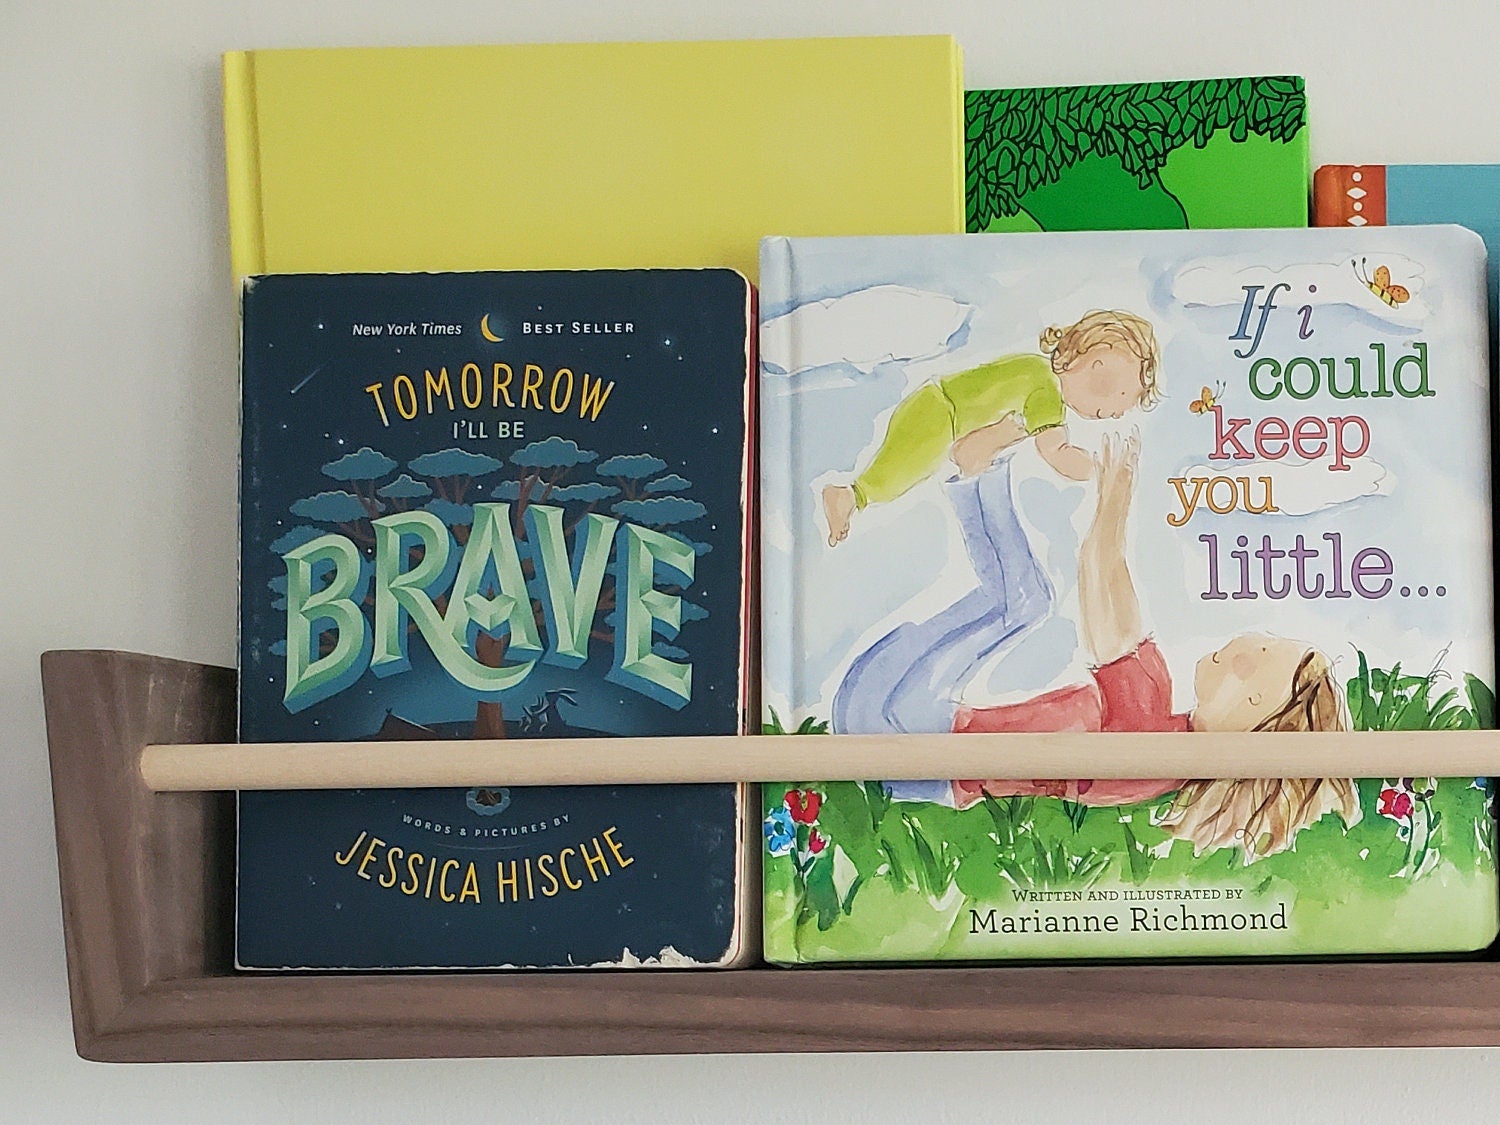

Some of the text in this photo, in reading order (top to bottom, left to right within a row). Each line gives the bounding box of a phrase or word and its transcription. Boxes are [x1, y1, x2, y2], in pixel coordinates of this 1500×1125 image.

[352, 321, 462, 336] New York Times
[522, 320, 635, 335] BEST SELLER
[1228, 284, 1317, 358] If i
[365, 362, 615, 427] TOMORROW
[1249, 342, 1436, 401] could
[452, 419, 525, 439] I'LL BE
[1208, 405, 1370, 471] keep
[1167, 476, 1279, 526] you
[1199, 532, 1447, 600] little...
[282, 502, 696, 713] BRAVE
[402, 814, 572, 838] WORDS & PICTURES BY
[335, 826, 635, 903] JESSICA HISCHE
[968, 902, 1289, 934] Marianne Richmond
[1011, 887, 1244, 903] WRITTEN AND ILLUSTRATED BY
